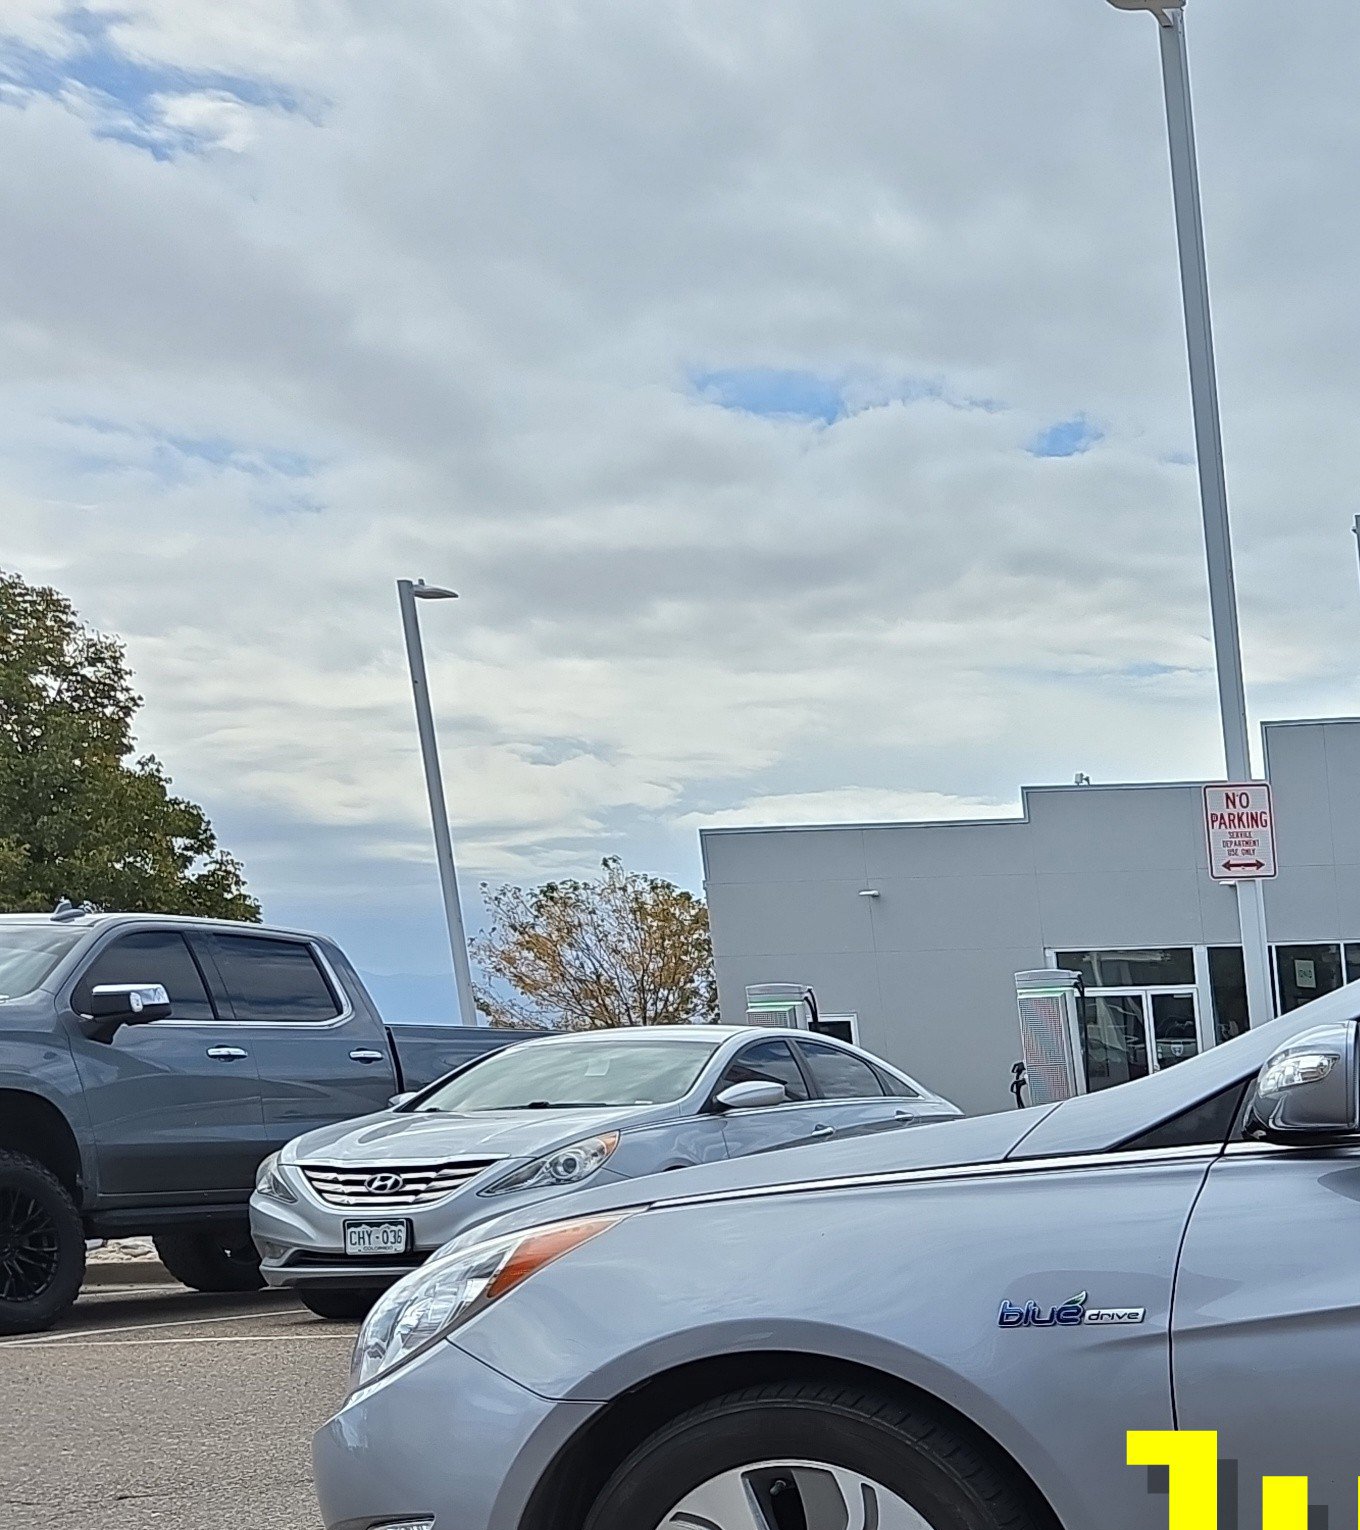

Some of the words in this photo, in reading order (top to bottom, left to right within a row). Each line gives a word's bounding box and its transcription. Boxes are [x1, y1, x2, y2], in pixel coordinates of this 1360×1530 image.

[1225, 792, 1250, 809] NO
[1210, 811, 1268, 829] PARKING
[1222, 840, 1259, 848] DEPARTMENT
[1227, 848, 1239, 856] USE
[999, 1300, 1083, 1328] blue
[1088, 1311, 1139, 1322] drive
